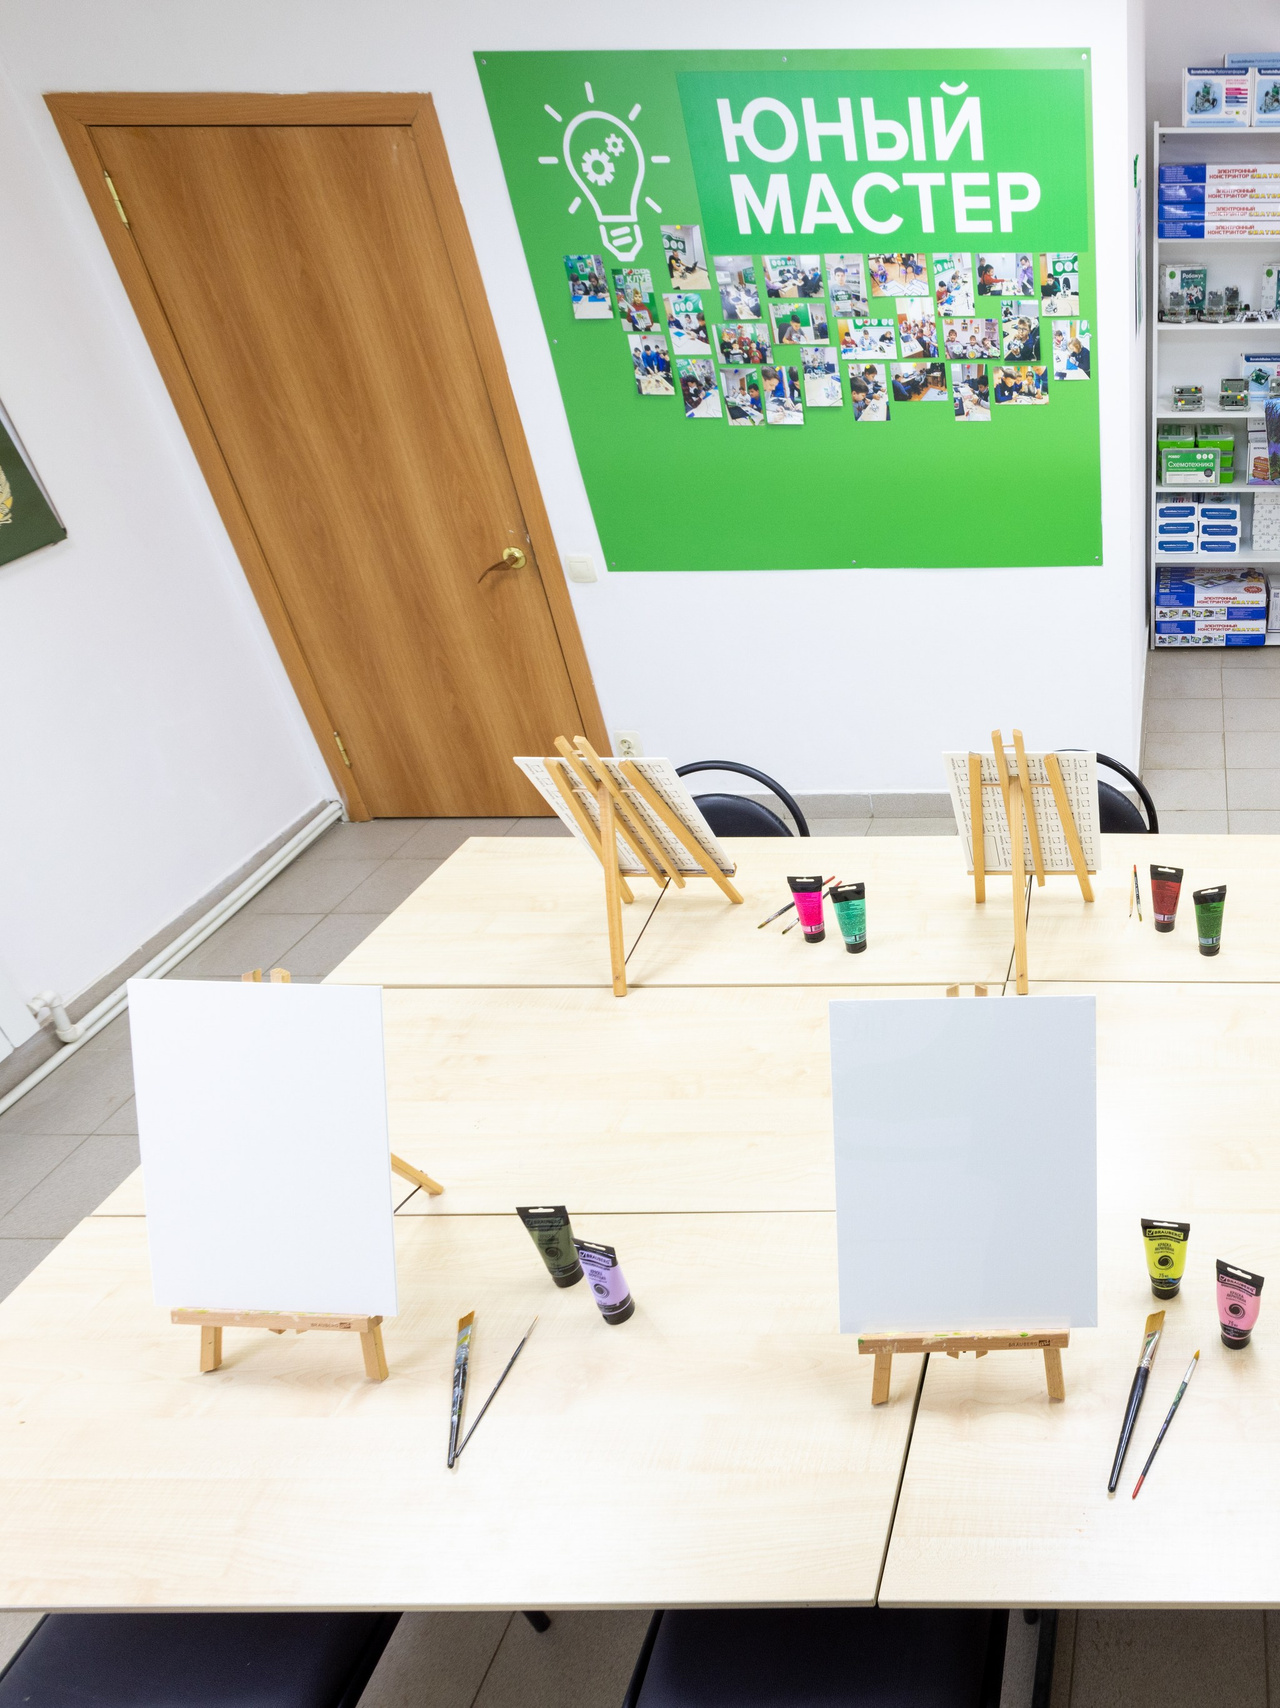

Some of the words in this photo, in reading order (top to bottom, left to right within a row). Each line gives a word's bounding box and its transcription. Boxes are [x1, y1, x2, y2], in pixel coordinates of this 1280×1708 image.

[716, 81, 984, 163] ЮНЫЙ
[729, 172, 1041, 235] МАСТЕР
[1154, 1230, 1181, 1238] BRAUBERG
[586, 1251, 610, 1264] BRAUBERG
[1227, 1278, 1254, 1292] BRAUBERG
